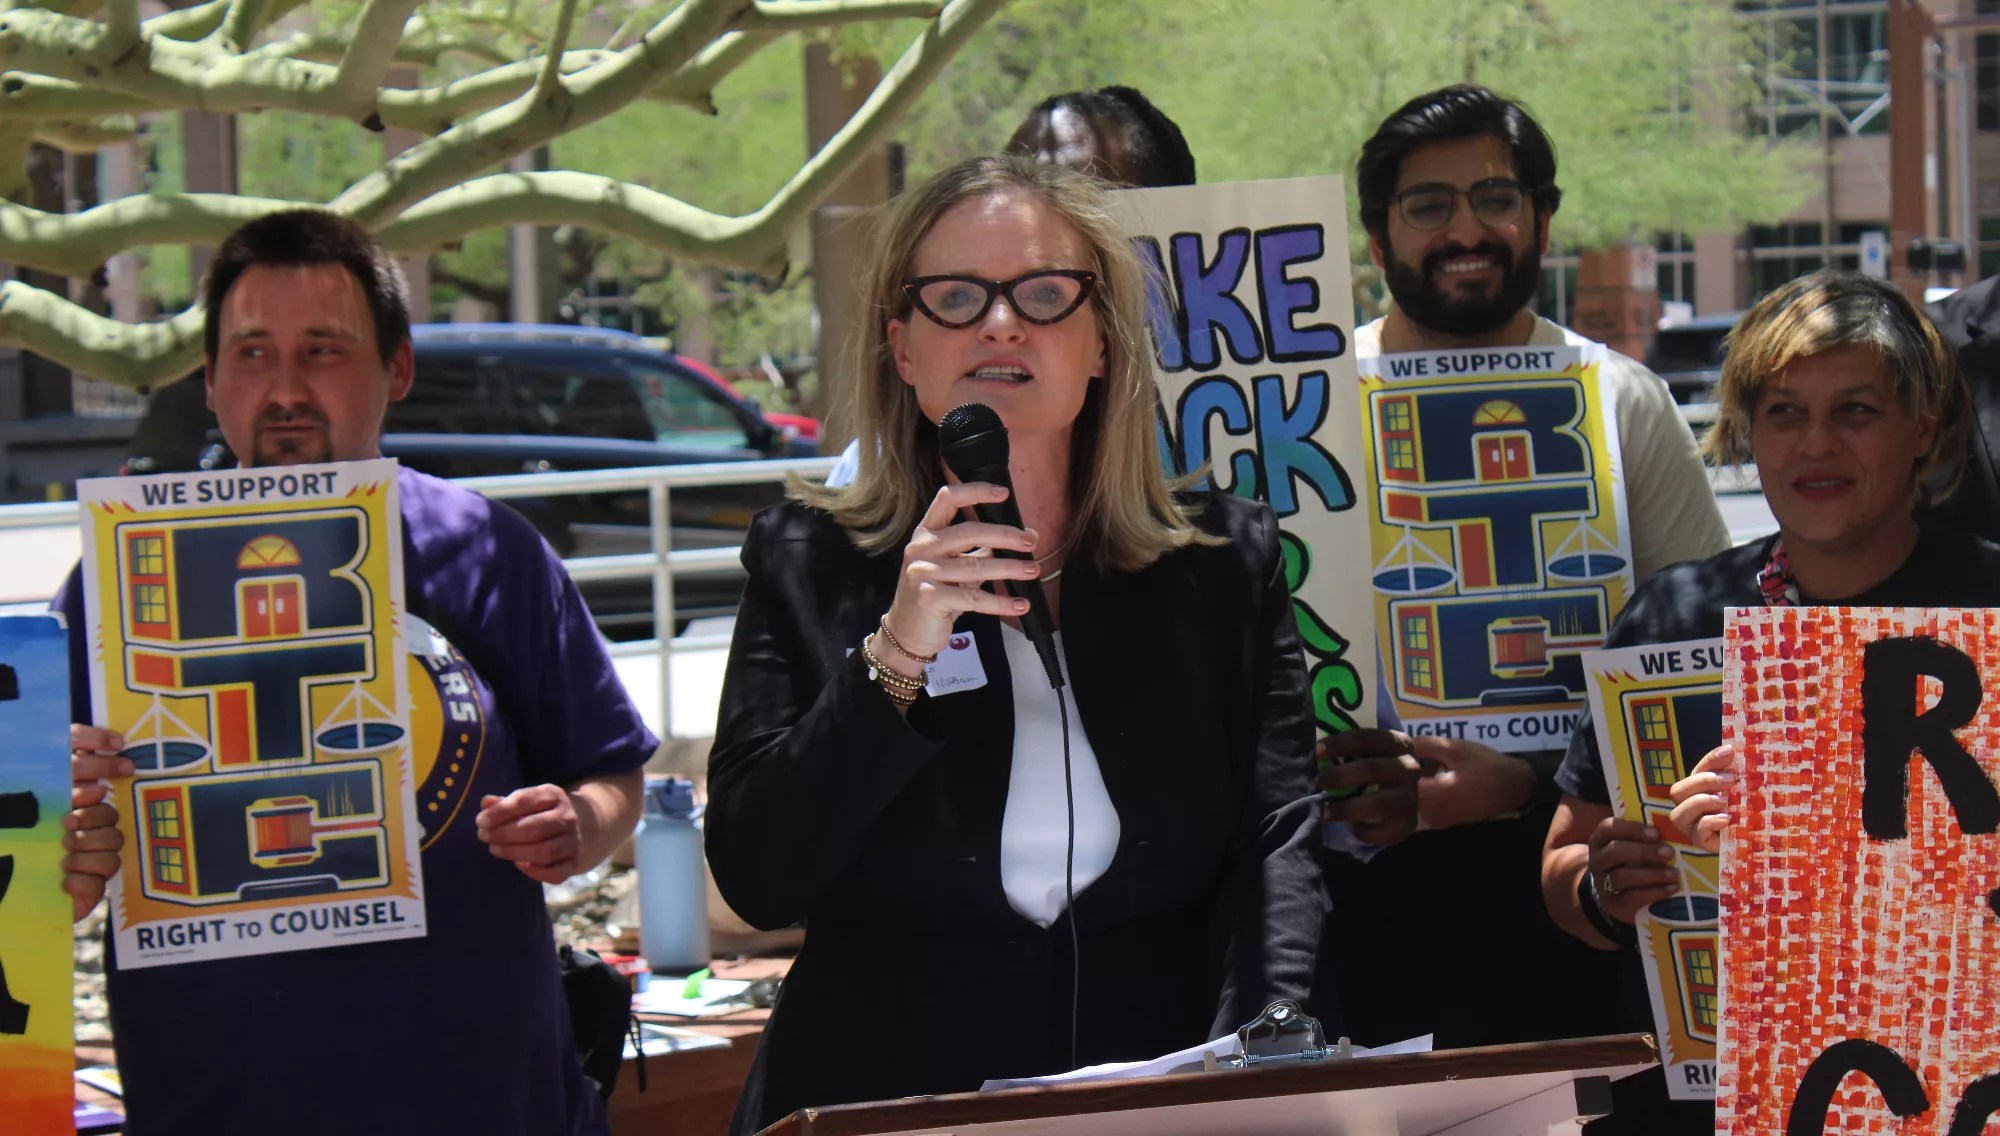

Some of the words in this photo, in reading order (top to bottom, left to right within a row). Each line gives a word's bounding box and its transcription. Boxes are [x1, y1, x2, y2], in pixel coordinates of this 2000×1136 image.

[1390, 358, 1429, 377] WE
[1435, 351, 1555, 374] SUPPORT
[142, 482, 187, 506] WE
[196, 471, 338, 502] SUPPORT
[1640, 652, 1684, 675] WE
[1475, 724, 1500, 739] TO
[1507, 713, 1578, 737] COUN
[136, 919, 226, 950] RIGHT
[233, 922, 262, 940] TO
[269, 901, 405, 935] COUNSEL
